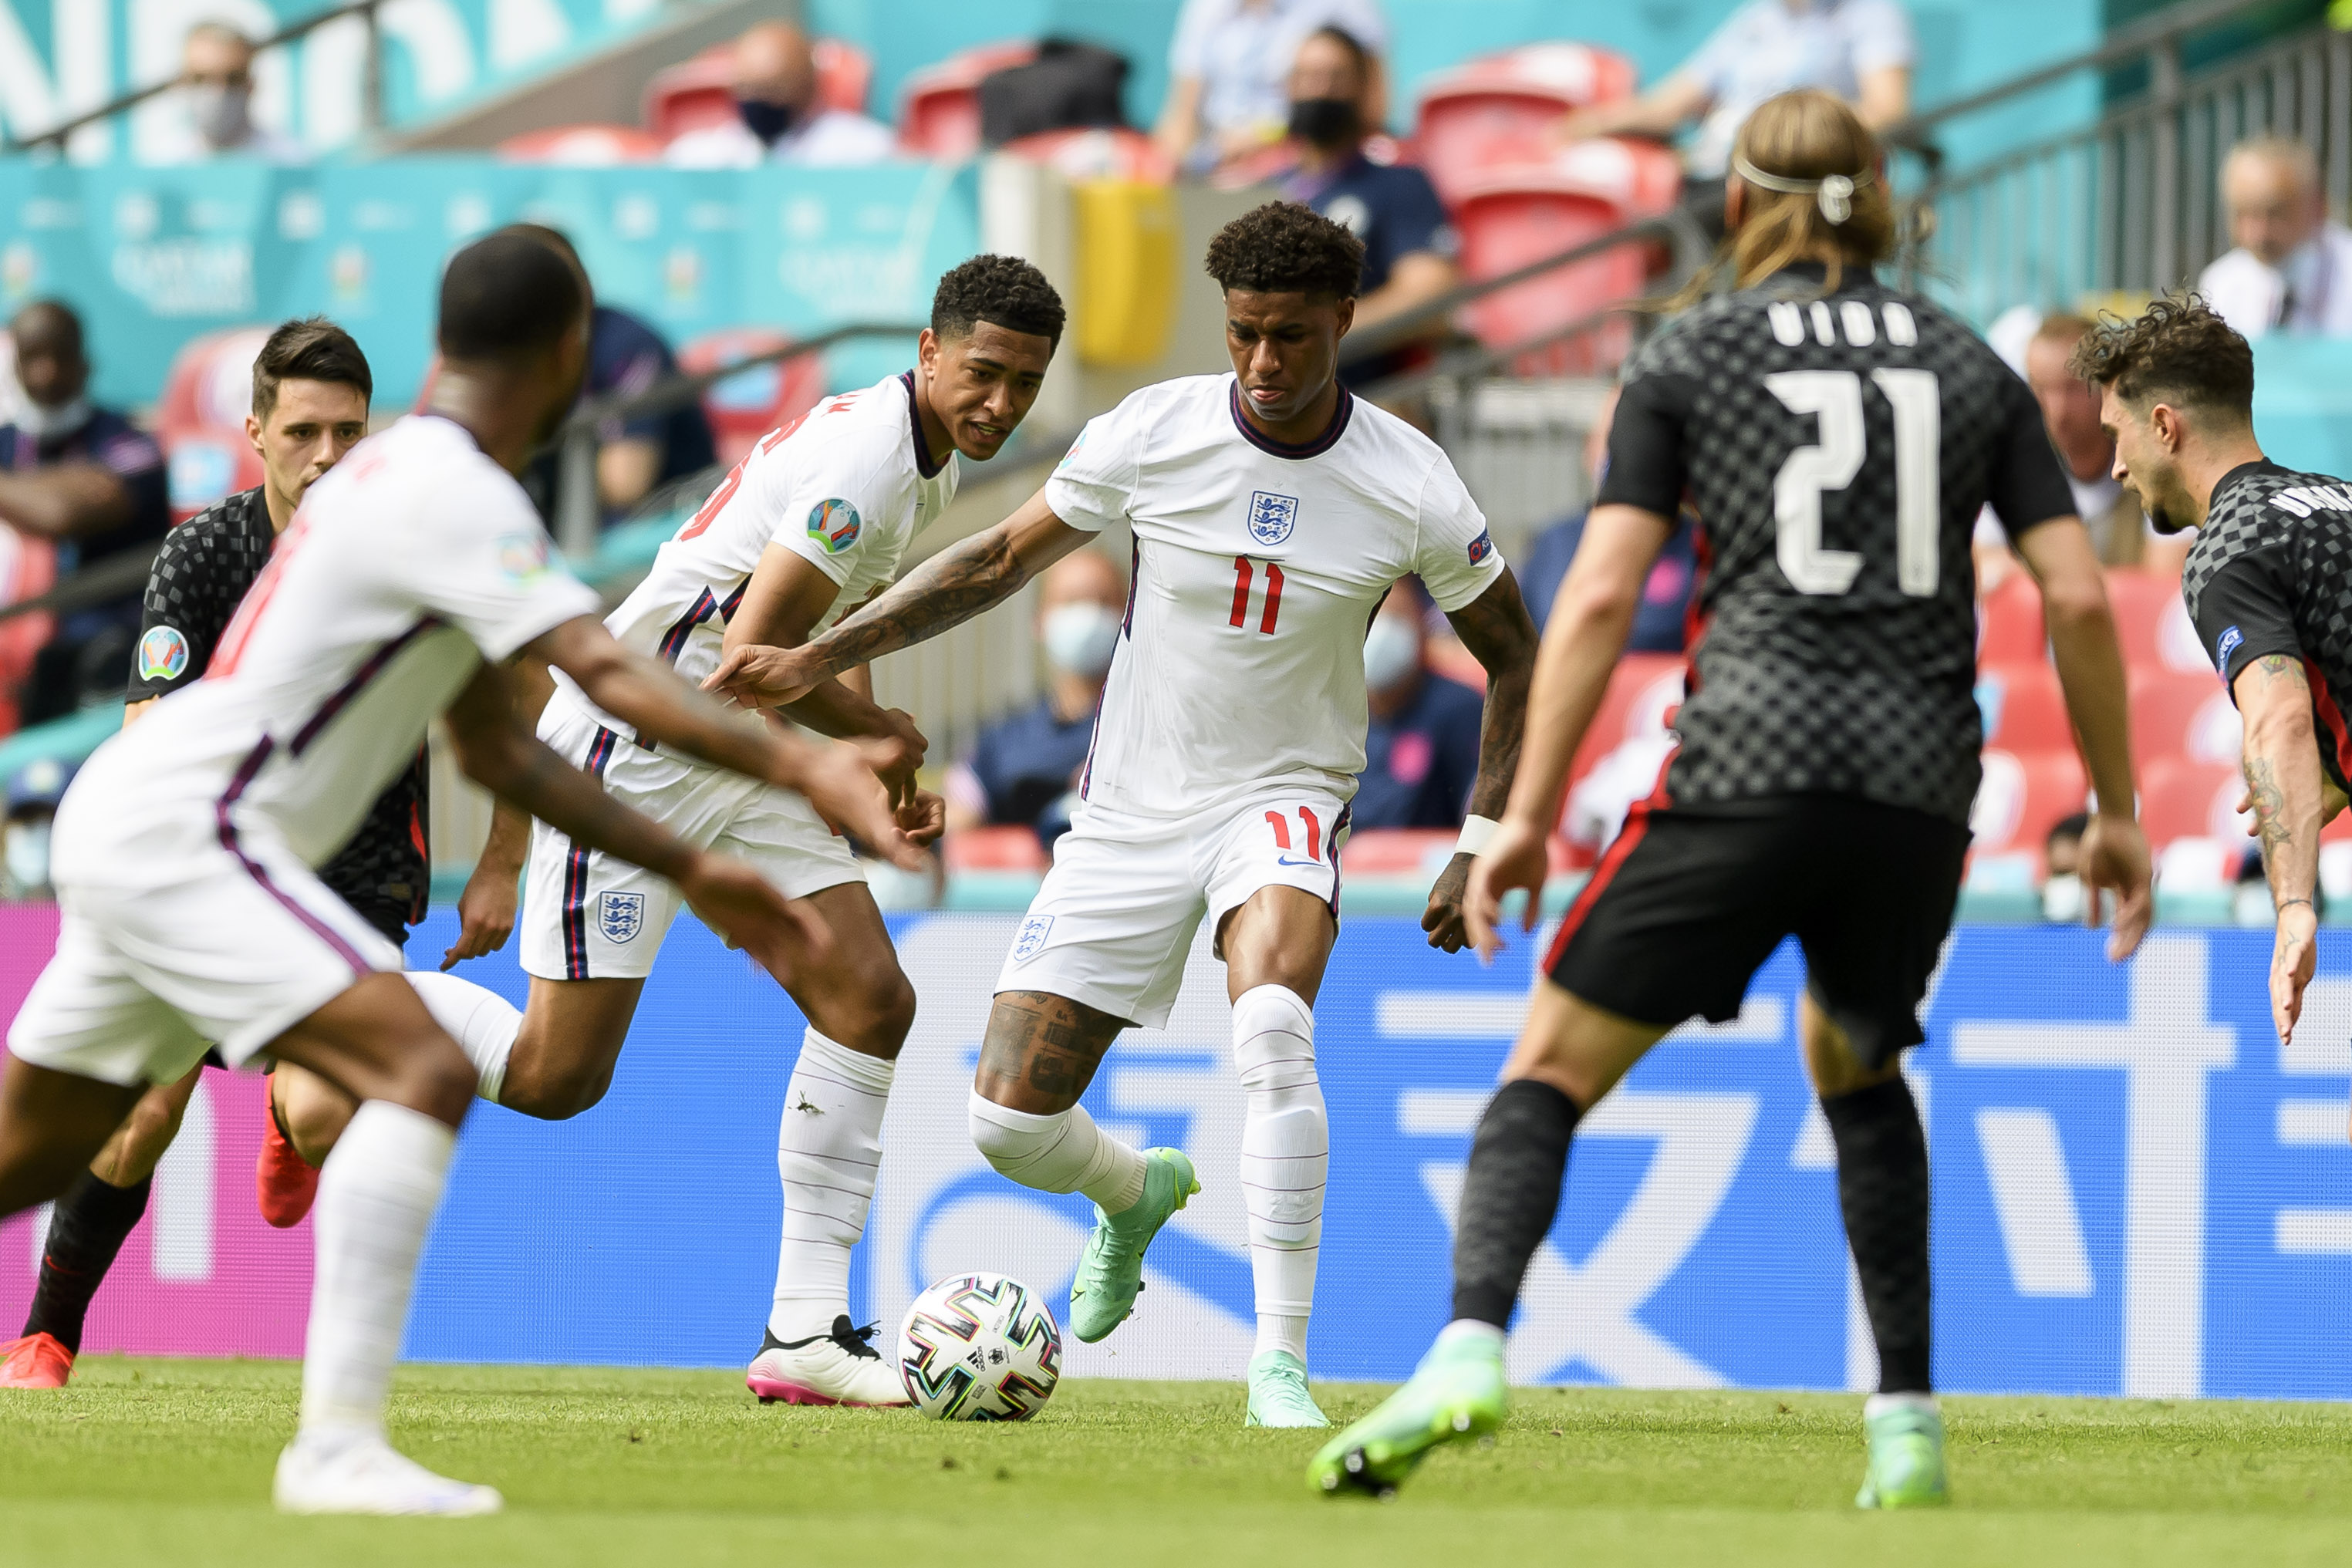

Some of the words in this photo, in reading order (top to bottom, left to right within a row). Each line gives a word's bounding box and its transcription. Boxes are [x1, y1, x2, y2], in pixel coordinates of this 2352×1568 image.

[1763, 366, 1942, 599] 21
[1229, 555, 1285, 636] 11
[1264, 805, 1320, 862] 11
